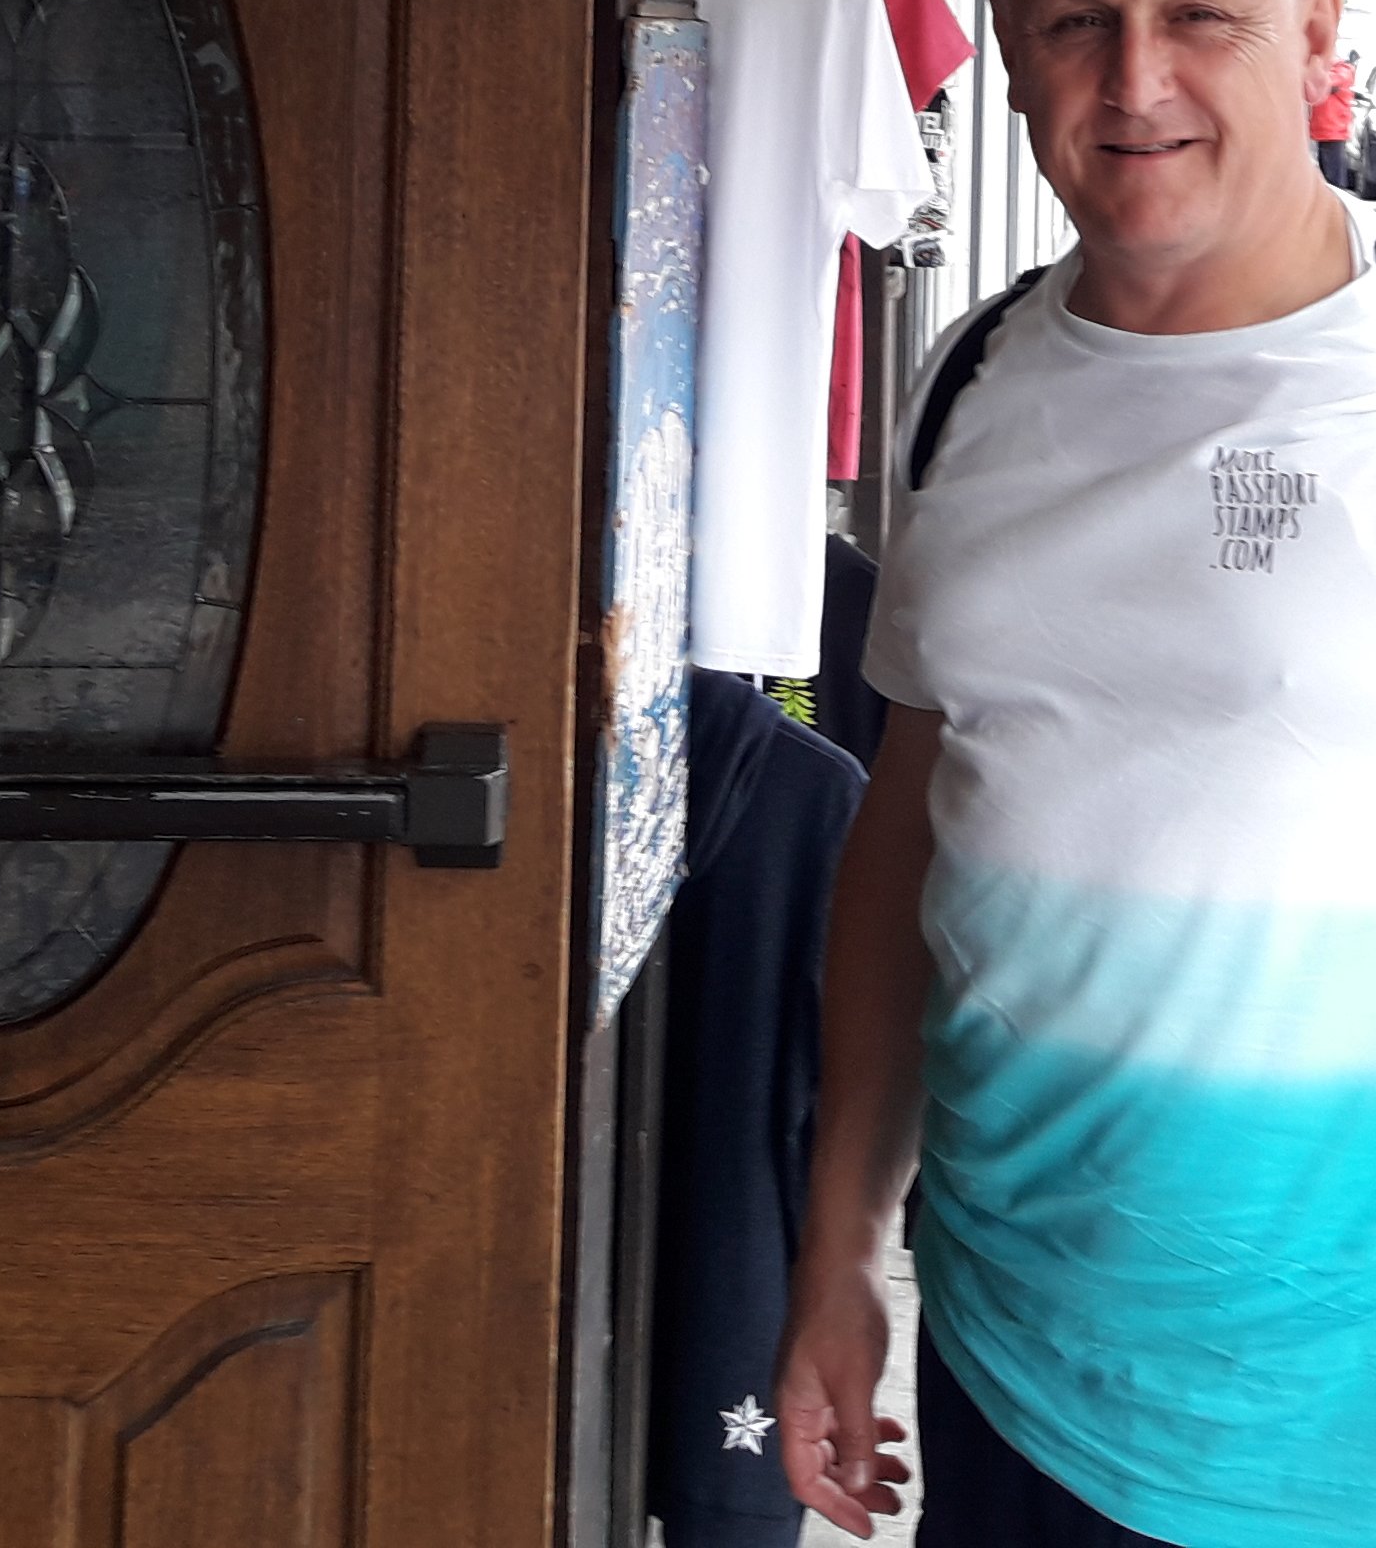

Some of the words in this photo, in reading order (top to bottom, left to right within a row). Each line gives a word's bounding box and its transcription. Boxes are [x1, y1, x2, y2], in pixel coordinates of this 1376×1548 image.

[1209, 473, 1320, 505] PASSPORT
[1212, 506, 1302, 540] STAMPS
[1209, 539, 1275, 574] .COM
